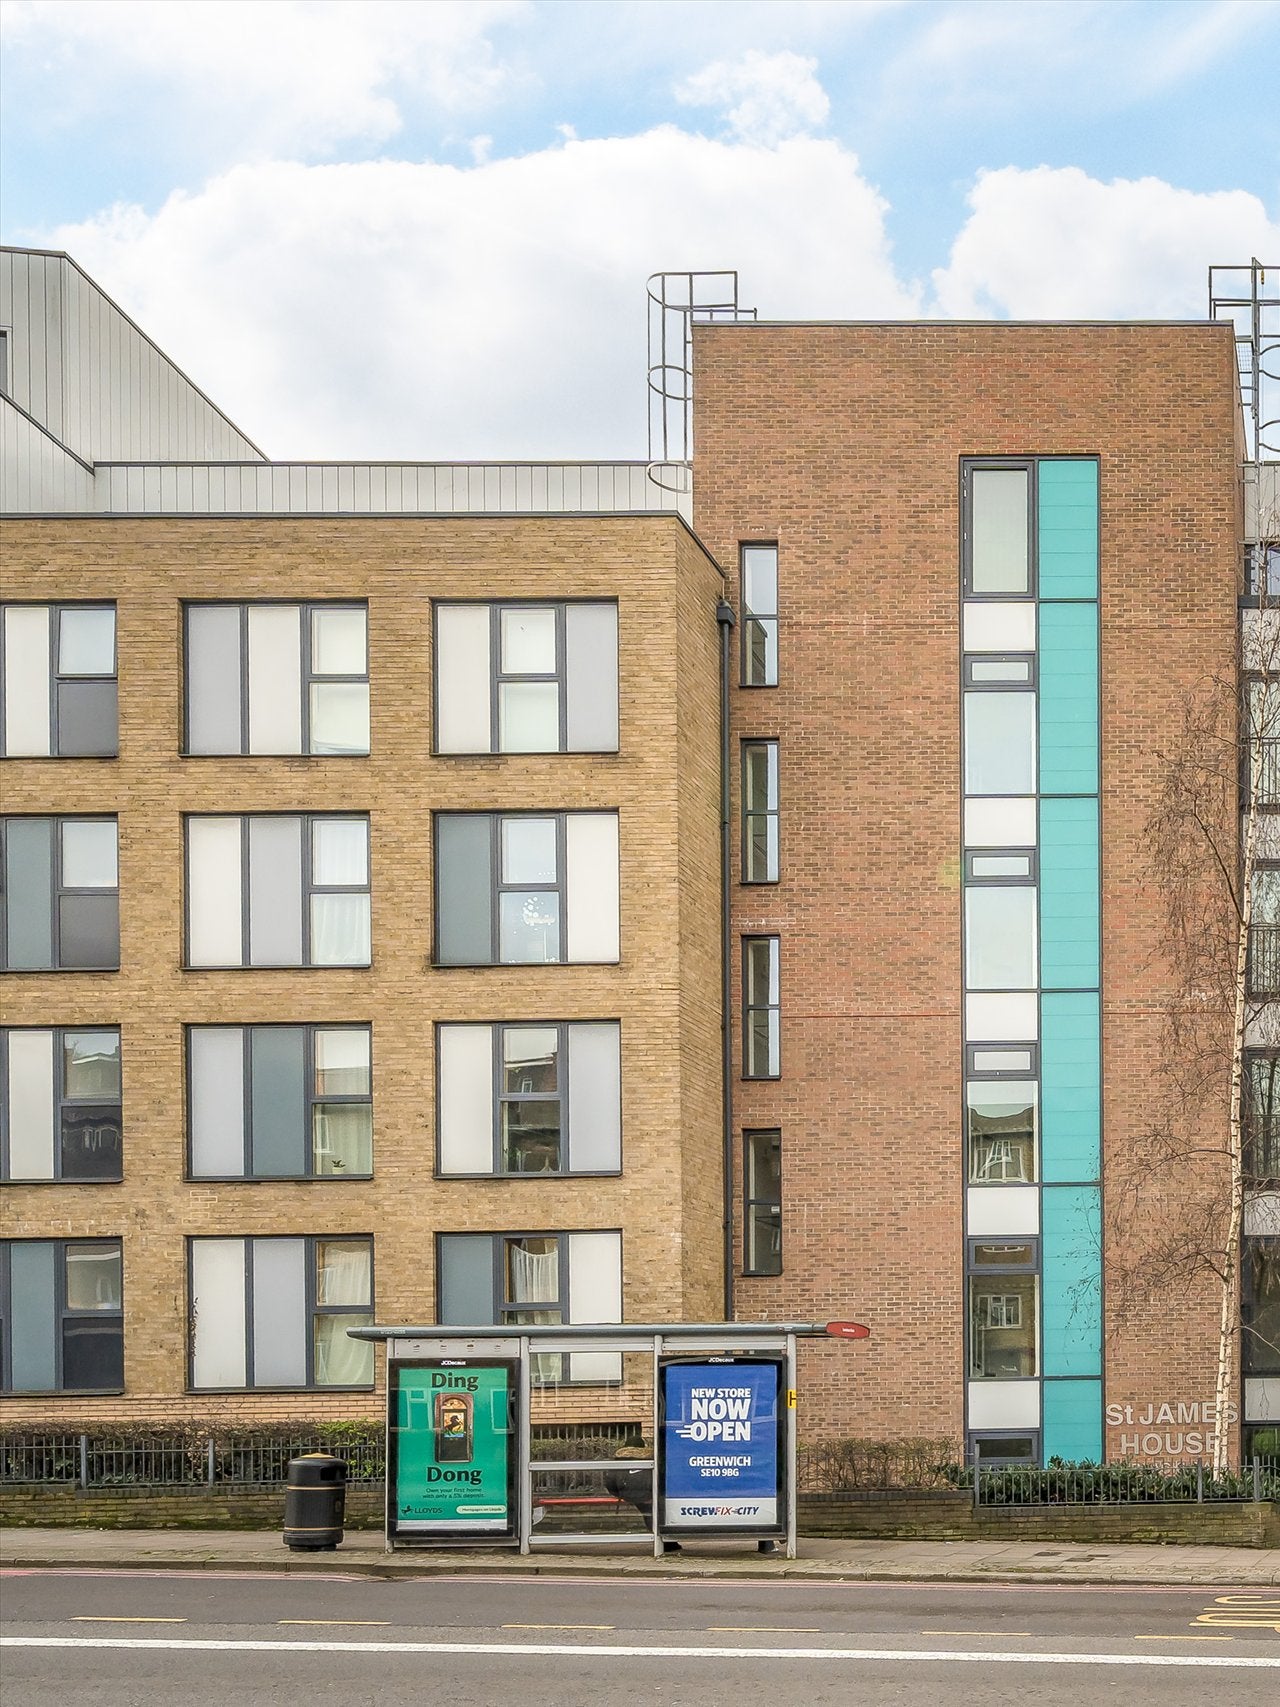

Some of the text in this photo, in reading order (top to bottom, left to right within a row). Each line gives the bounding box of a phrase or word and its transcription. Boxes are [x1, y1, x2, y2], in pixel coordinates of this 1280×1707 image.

[431, 1372, 479, 1391] Ding
[691, 1388, 751, 1398] NEW STORE
[691, 1399, 751, 1420] NOW
[1105, 1403, 1134, 1426] St
[691, 1421, 751, 1441] OPEN
[689, 1456, 751, 1467] GREENWICH
[427, 1466, 482, 1485] Dong
[700, 1468, 739, 1477] SE10 9BG
[737, 1506, 760, 1515] CITY
